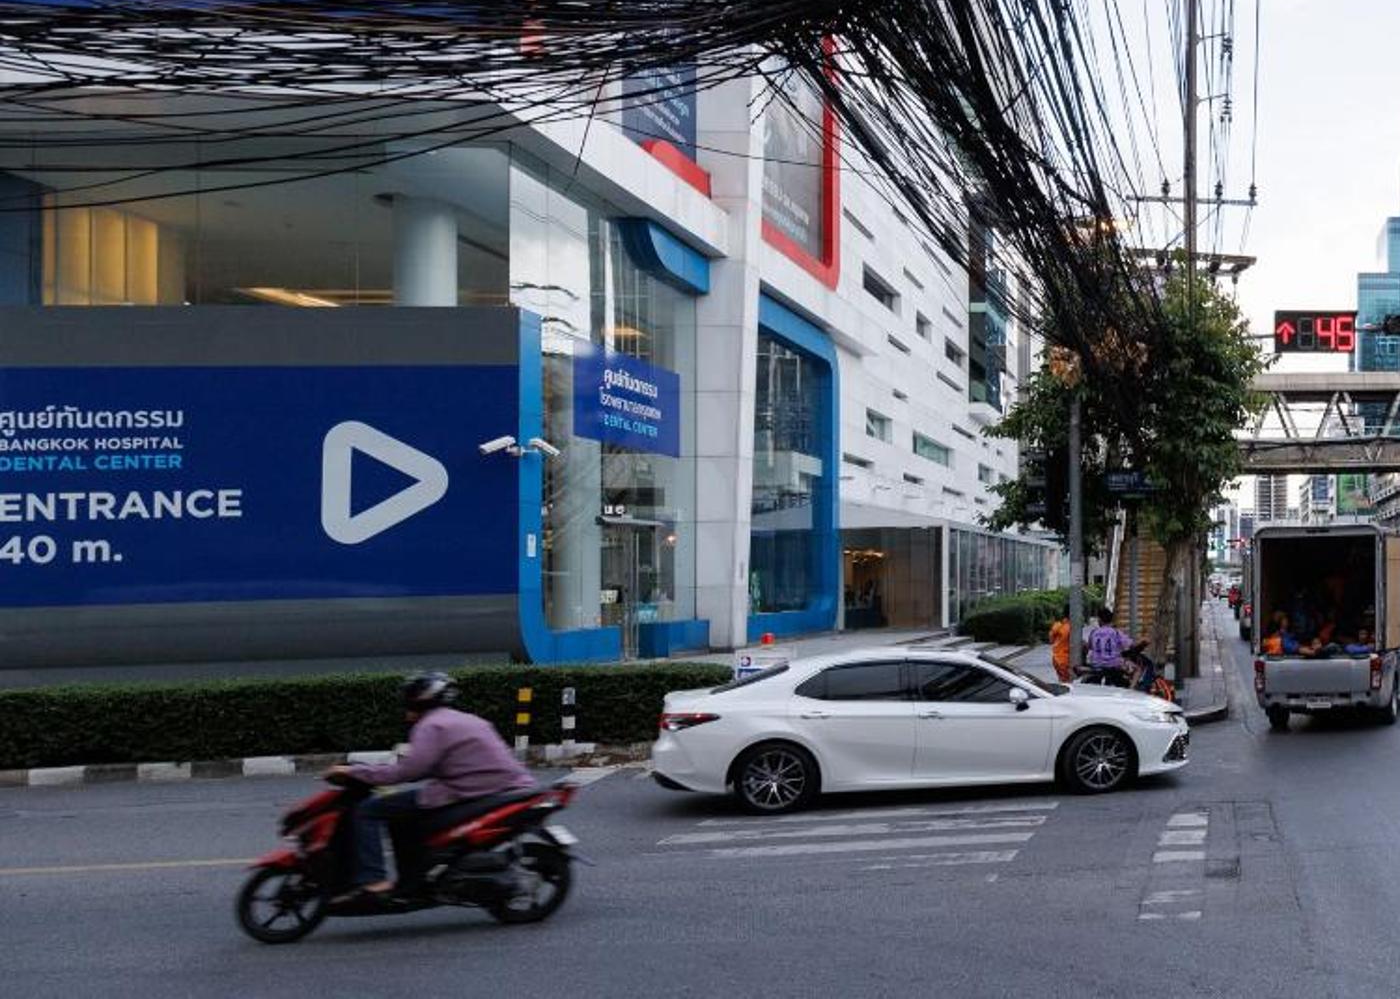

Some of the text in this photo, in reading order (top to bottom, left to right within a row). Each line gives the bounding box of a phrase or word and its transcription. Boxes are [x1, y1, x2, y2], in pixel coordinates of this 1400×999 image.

[1316, 316, 1354, 351] 45
[0, 405, 184, 437] ศูนย์ทันตกรรม
[95, 436, 184, 451] HOSPITAL
[0, 454, 182, 472] DENTAL CENTER
[0, 488, 243, 523] ENTRANCE
[0, 535, 123, 565] 40 m.
